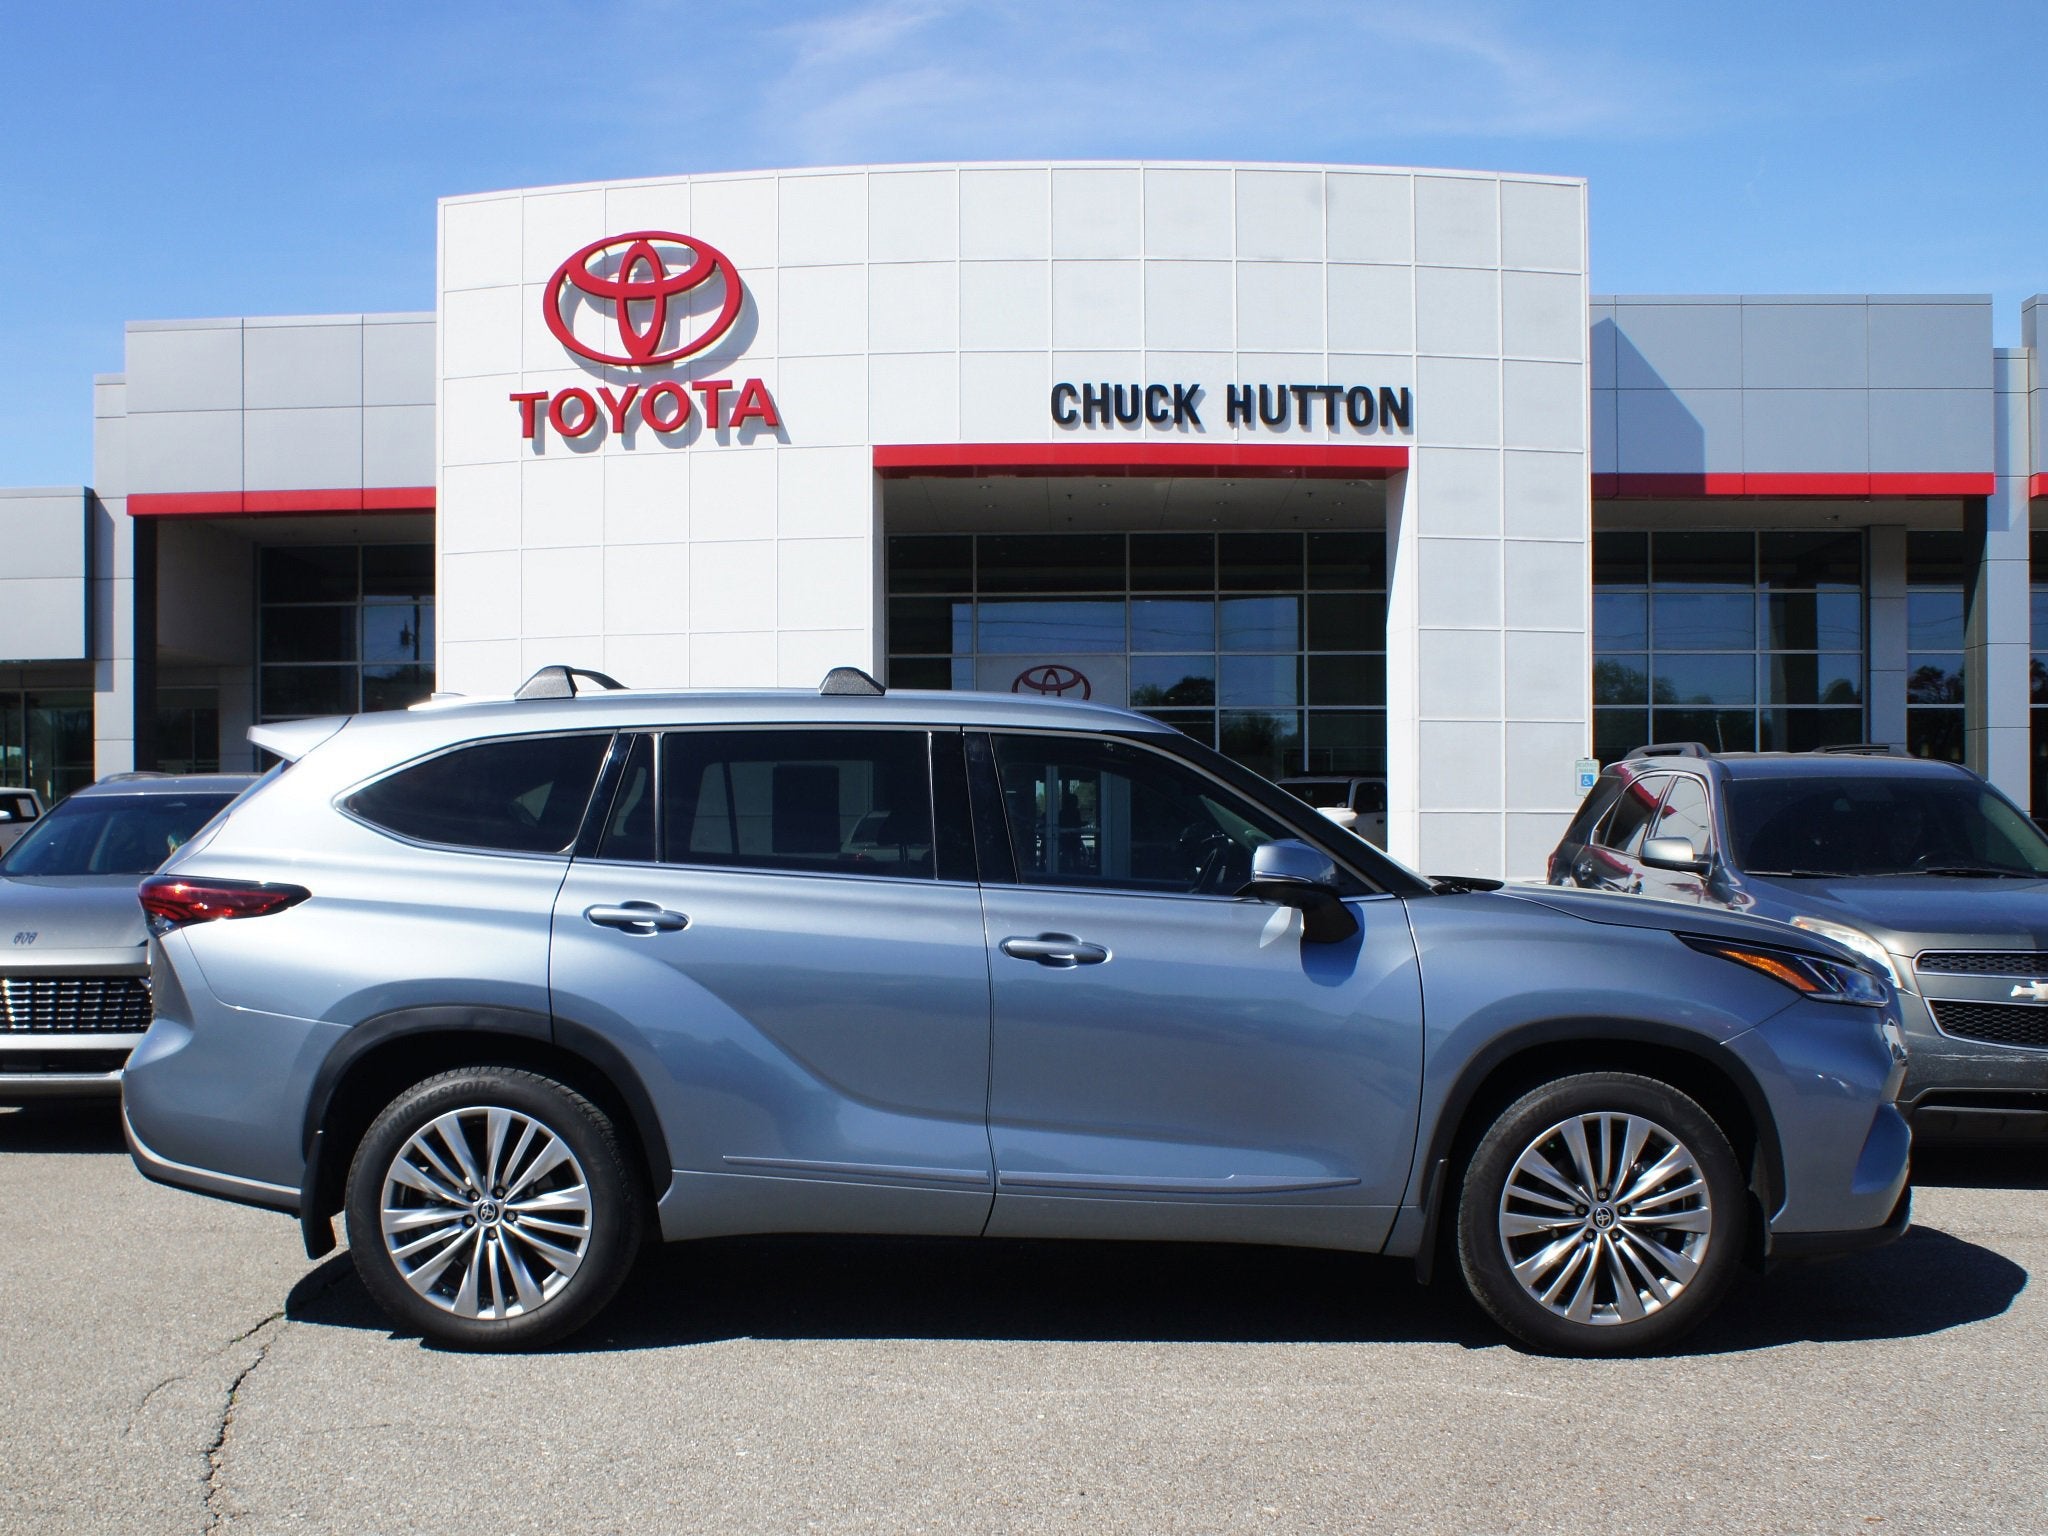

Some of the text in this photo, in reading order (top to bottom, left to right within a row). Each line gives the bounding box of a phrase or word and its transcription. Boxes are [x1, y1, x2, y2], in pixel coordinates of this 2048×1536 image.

[509, 378, 779, 438] TOYOTA
[1051, 382, 1410, 428] CHUCK HUTTON
